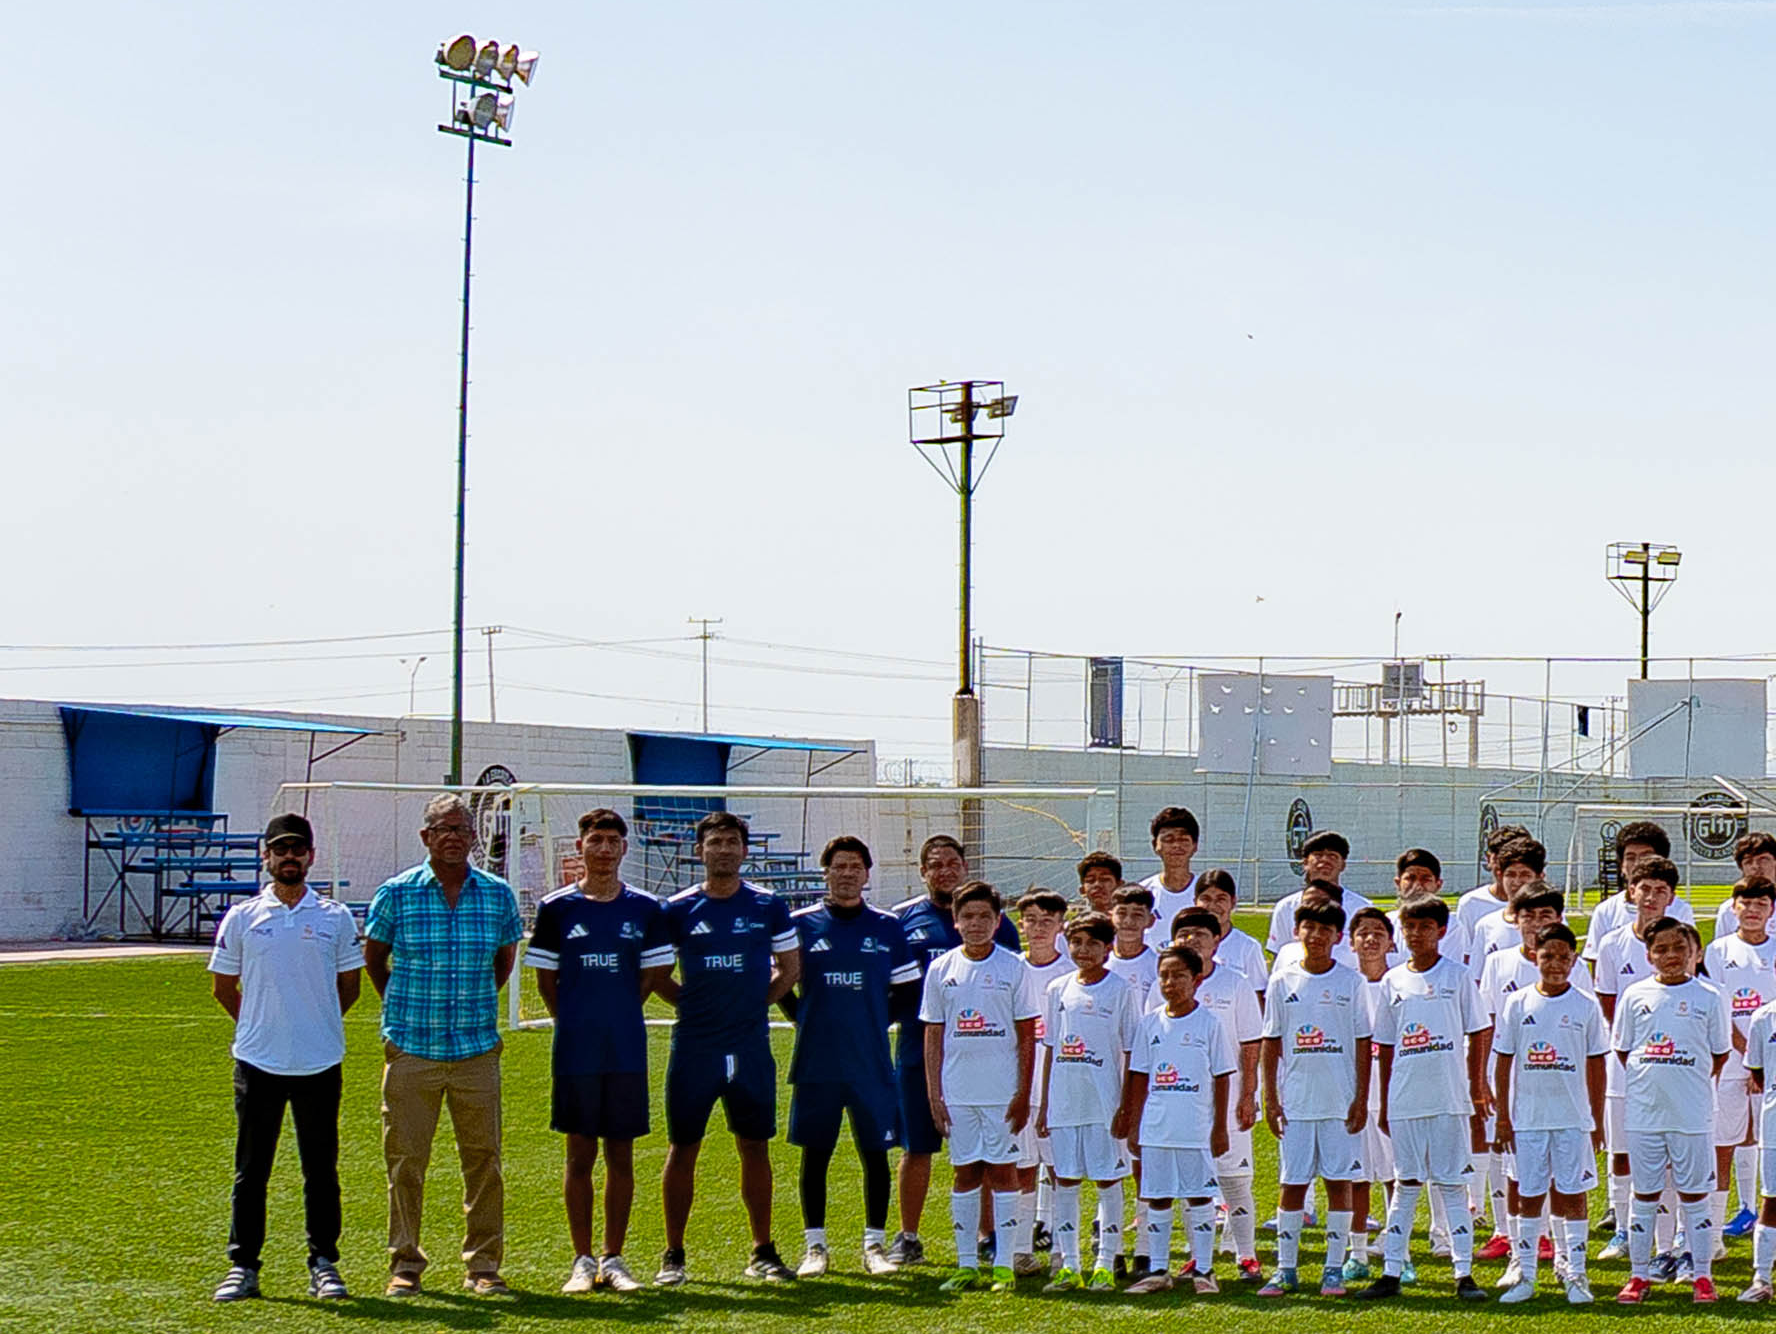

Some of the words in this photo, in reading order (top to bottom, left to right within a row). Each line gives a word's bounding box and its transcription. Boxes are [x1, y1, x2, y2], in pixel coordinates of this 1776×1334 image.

[580, 954, 619, 967] TRUE
[704, 954, 743, 968] TRUE
[824, 972, 863, 985] TRUE
